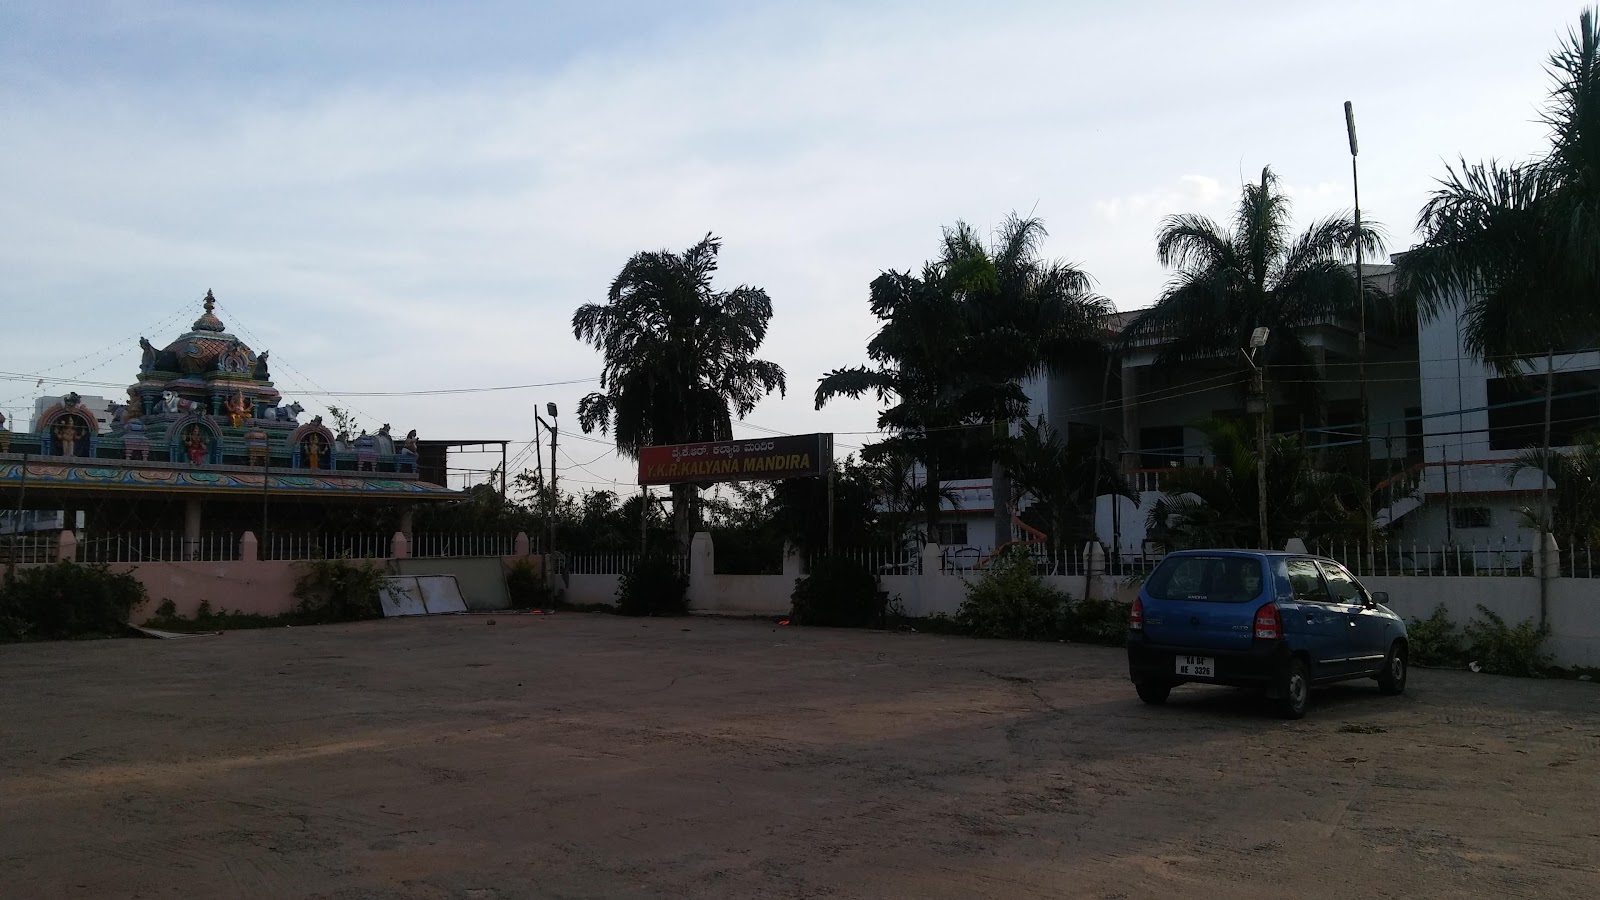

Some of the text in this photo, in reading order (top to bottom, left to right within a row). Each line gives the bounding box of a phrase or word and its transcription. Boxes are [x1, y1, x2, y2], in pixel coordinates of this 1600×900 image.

[744, 441, 775, 453] ಮಂದಿರ
[743, 454, 810, 473] MANDIRA
[1186, 656, 1195, 665] KA
